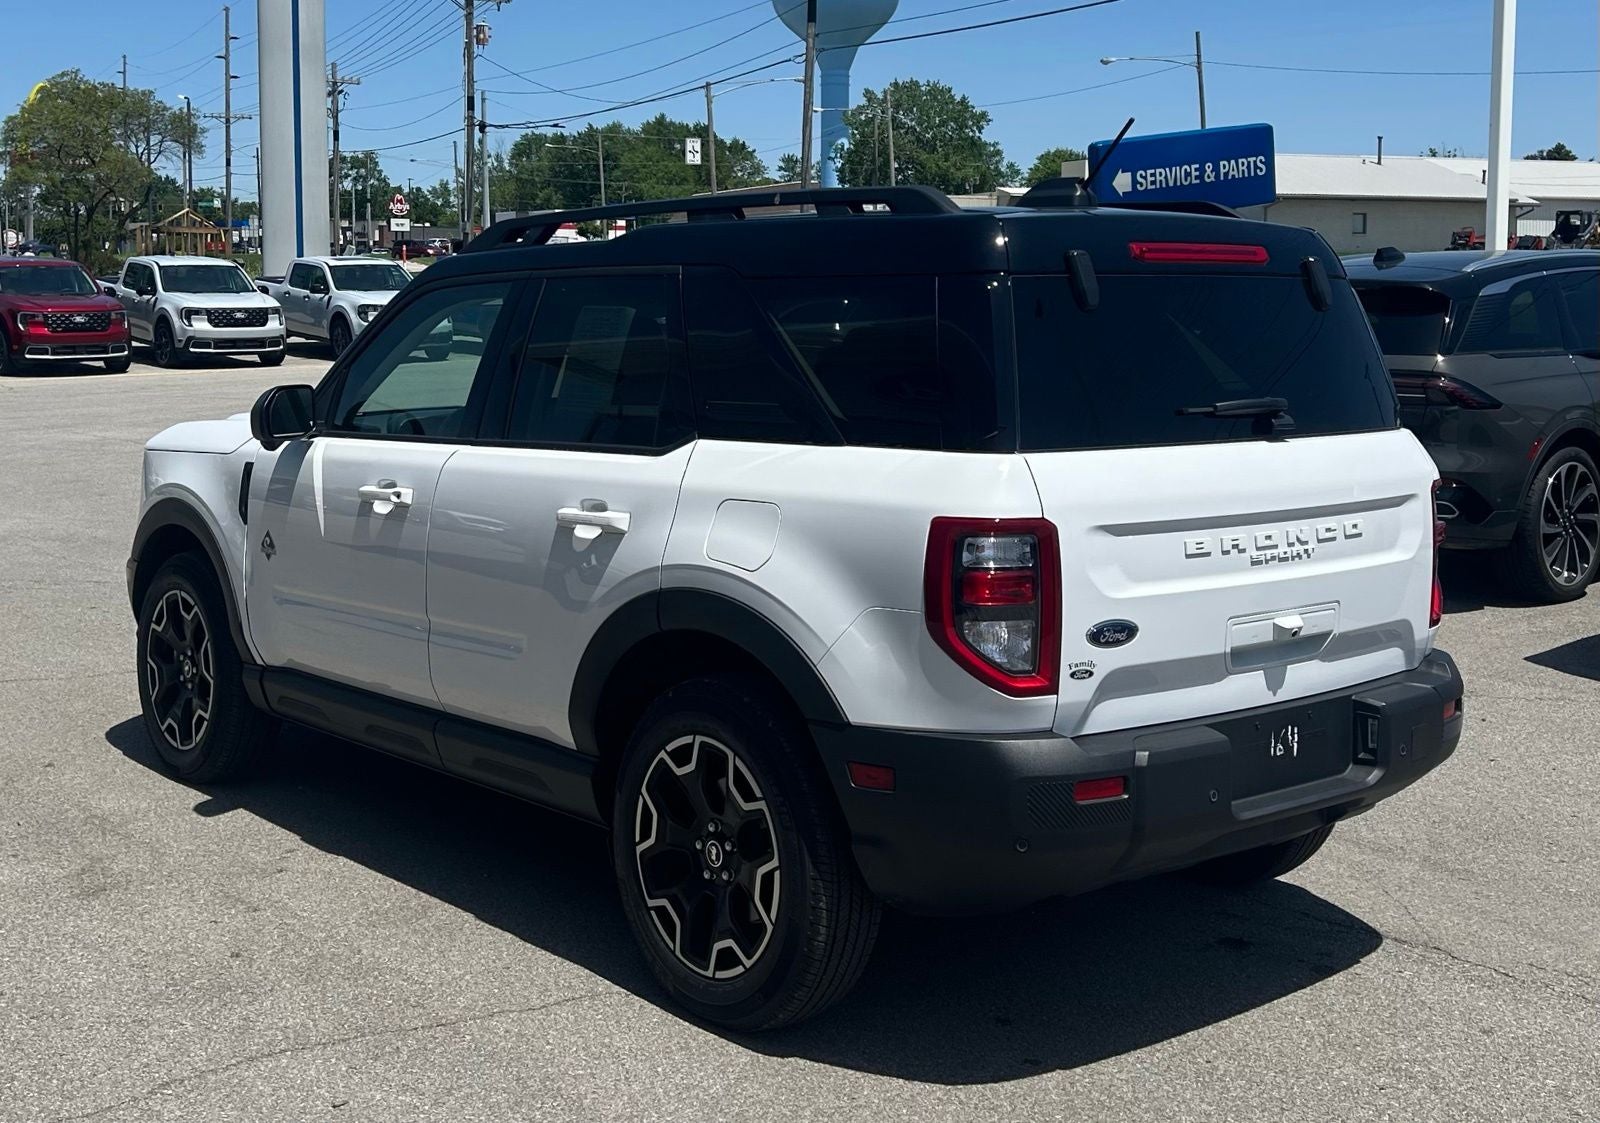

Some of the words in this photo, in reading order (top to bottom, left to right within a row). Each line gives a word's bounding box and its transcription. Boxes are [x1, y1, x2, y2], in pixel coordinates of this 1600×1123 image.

[1136, 163, 1201, 191] SERVICE
[1204, 162, 1216, 183] &
[1219, 155, 1267, 180] PARTS
[1184, 519, 1364, 559] BRONCO
[1250, 547, 1315, 566] SPORT
[1100, 627, 1129, 643] Ford
[1068, 660, 1097, 671] Family
[1073, 670, 1091, 680] Ford
[1271, 724, 1298, 757] 164
